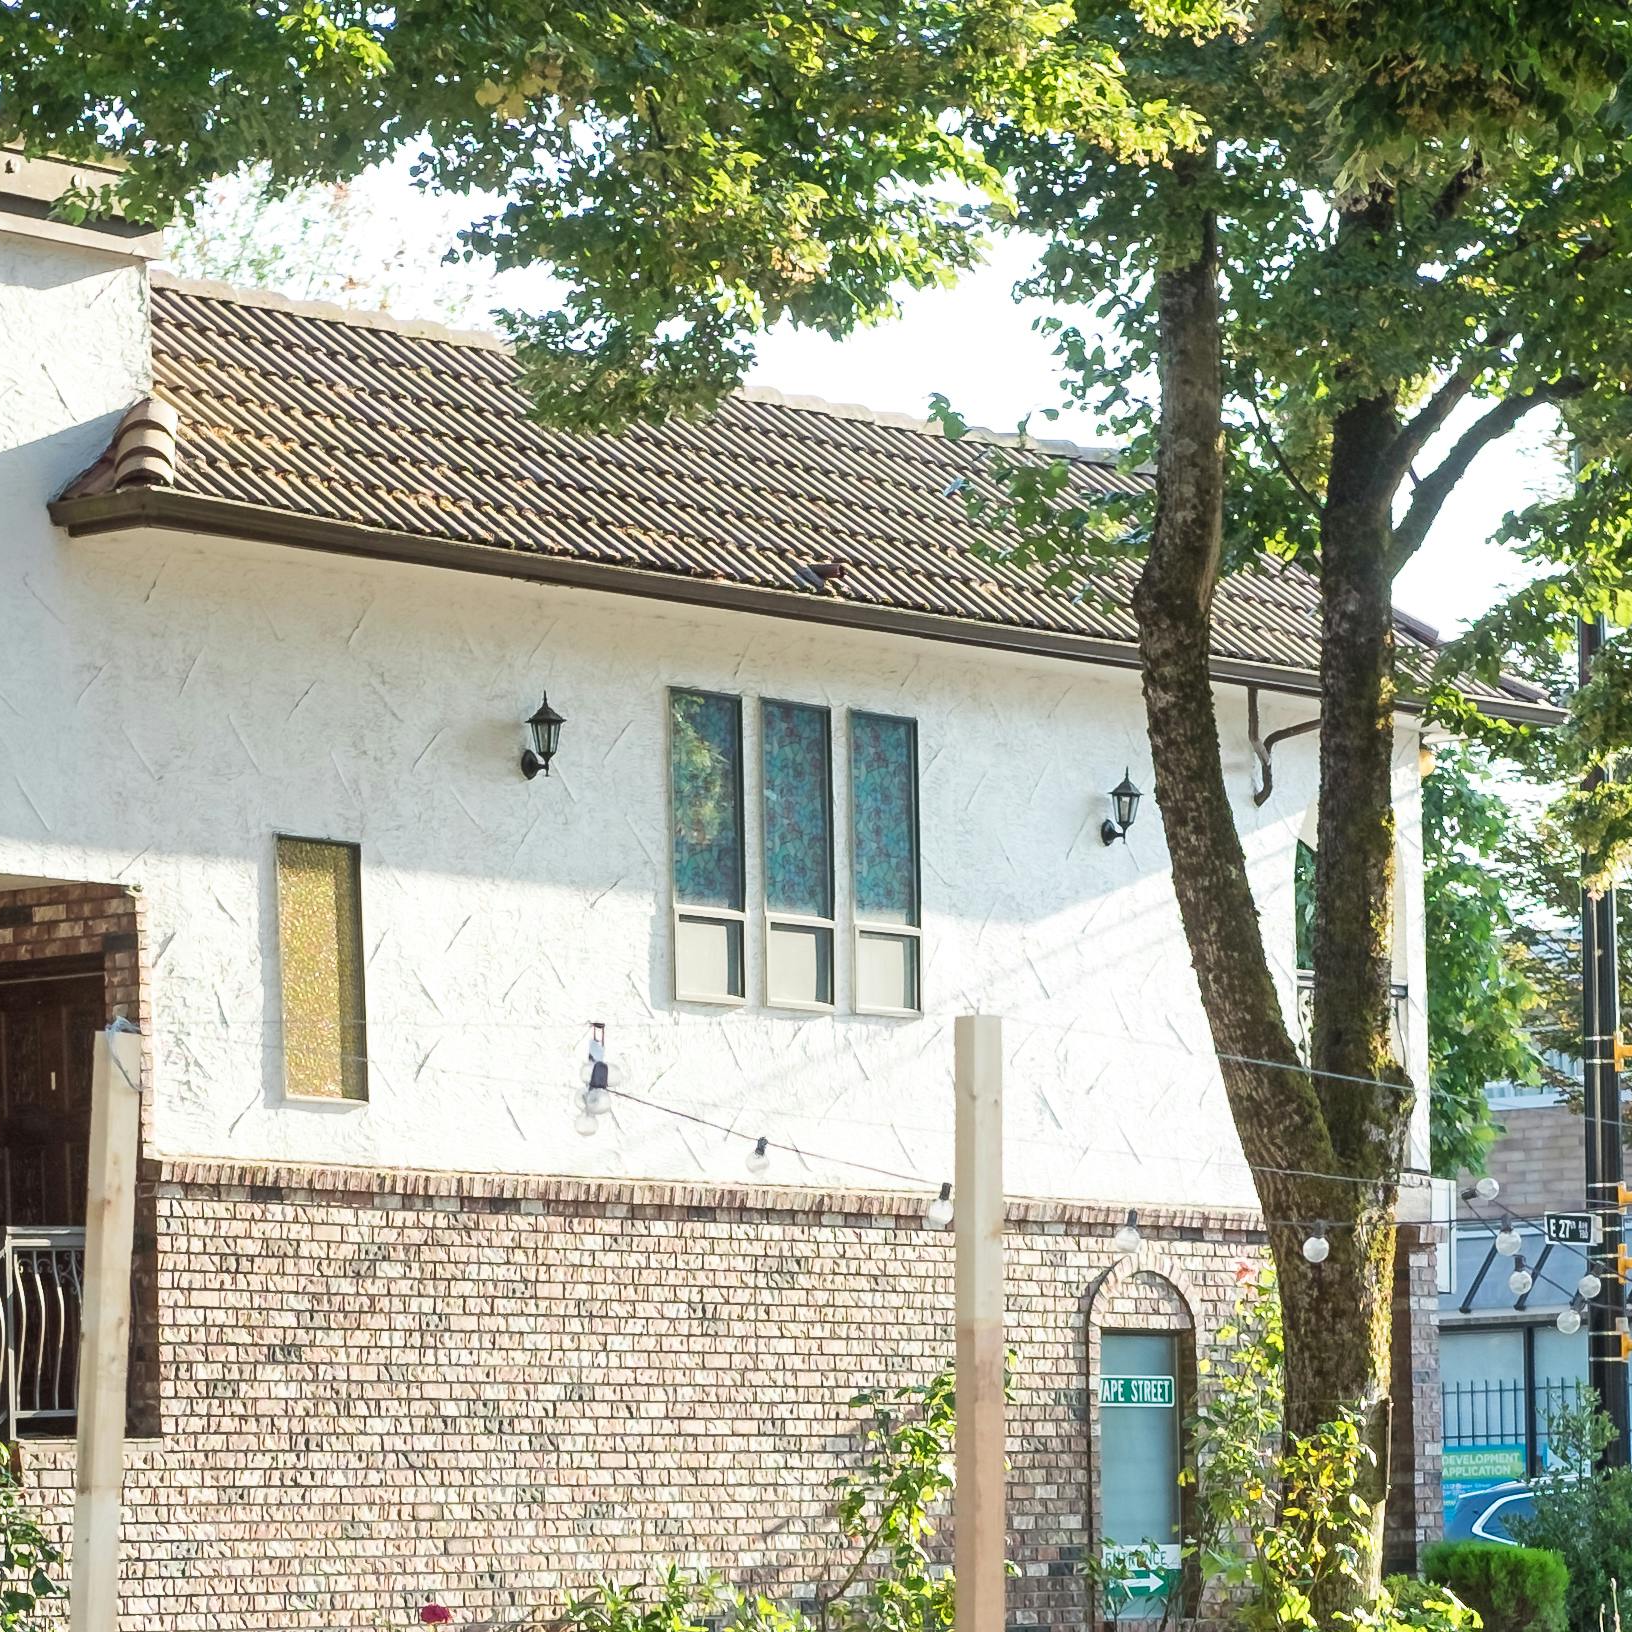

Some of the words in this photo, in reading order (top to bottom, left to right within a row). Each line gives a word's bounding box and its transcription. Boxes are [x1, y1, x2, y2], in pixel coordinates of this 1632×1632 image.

[1550, 1219, 1557, 1238] E
[1131, 1380, 1170, 1402] STREET
[1441, 1452, 1520, 1467] DEVELOPMENT
[1441, 1465, 1512, 1477] APPLICATION
